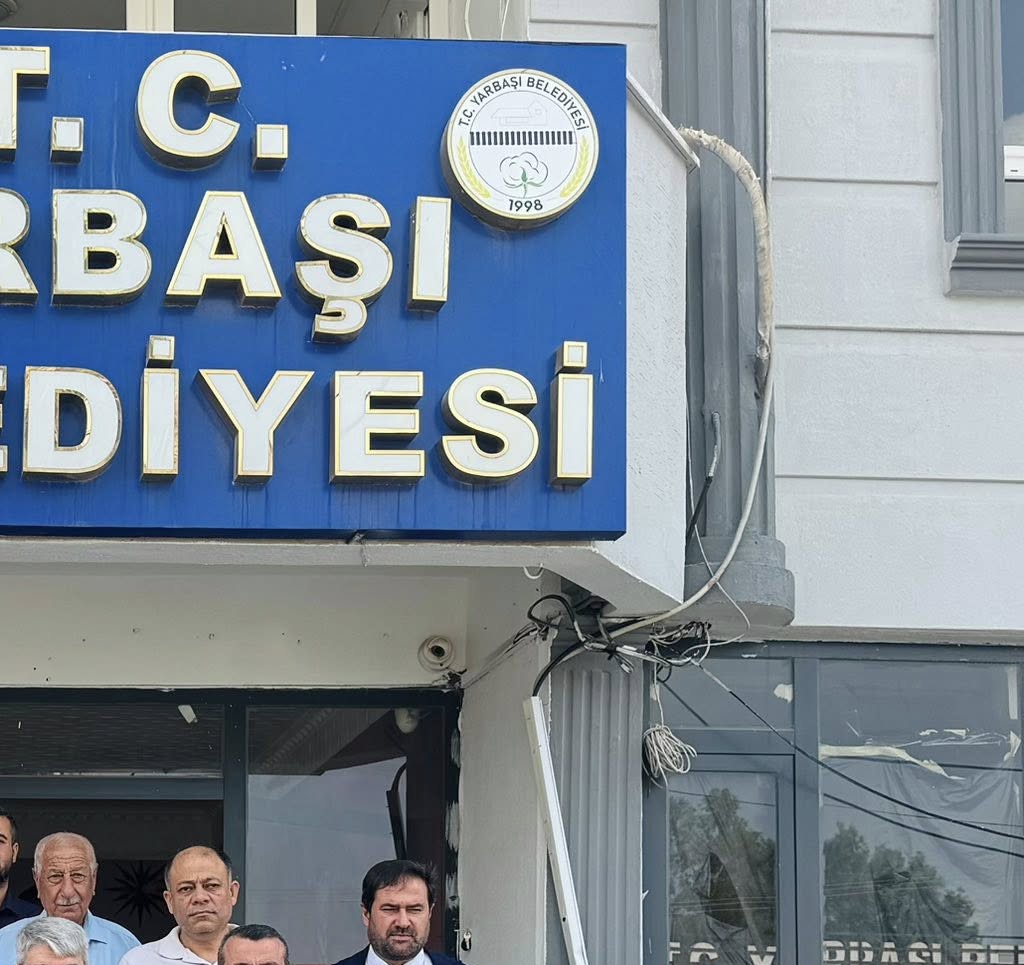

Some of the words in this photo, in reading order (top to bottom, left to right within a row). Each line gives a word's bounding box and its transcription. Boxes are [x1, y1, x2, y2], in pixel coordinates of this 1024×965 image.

[137, 49, 289, 163] C.
[458, 108, 476, 127] T.C.
[470, 76, 522, 106] YARBAŞI
[526, 76, 590, 131] BELEDİYESİ
[508, 199, 544, 212] 1998
